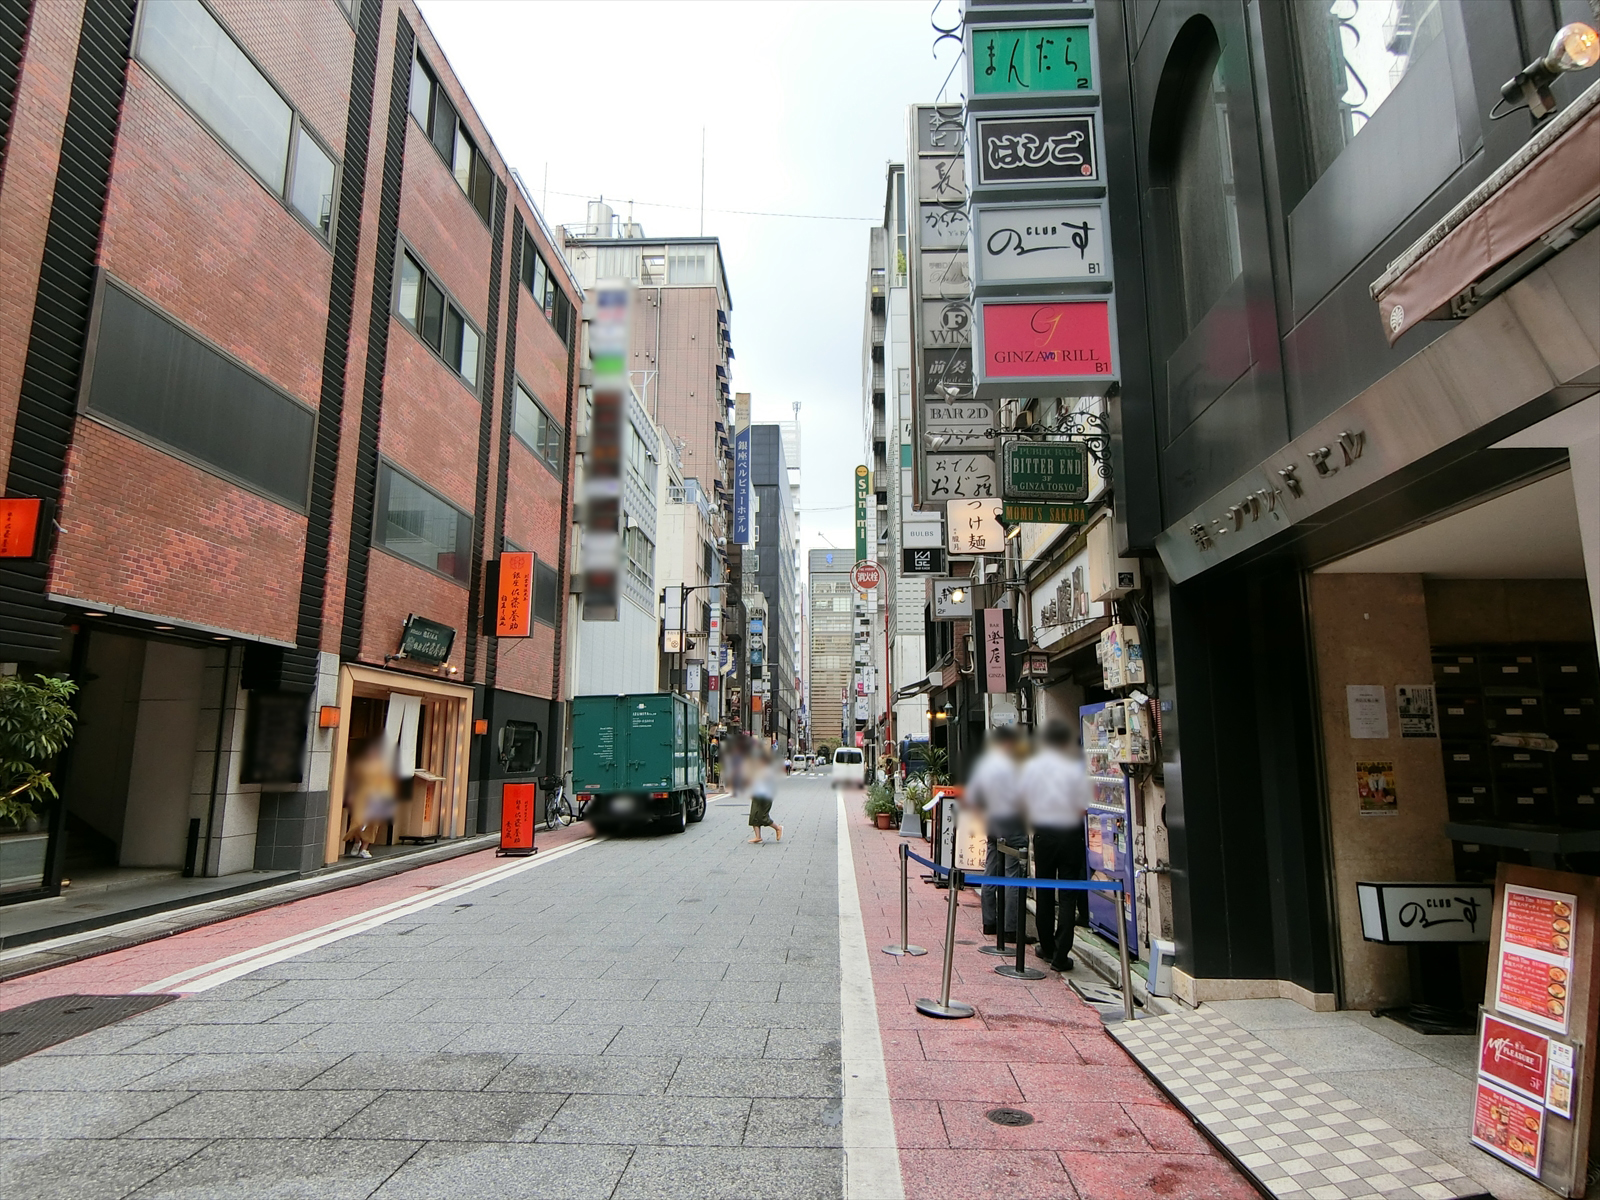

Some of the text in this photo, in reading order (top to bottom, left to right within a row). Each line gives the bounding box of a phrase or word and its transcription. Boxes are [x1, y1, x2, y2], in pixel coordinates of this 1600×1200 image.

[984, 37, 1077, 87] まんだら
[1077, 78, 1088, 88] 2
[987, 131, 1084, 169] はしご
[1026, 226, 1057, 236] CLUB
[1088, 262, 1100, 274] B1
[994, 350, 1046, 363] GINZA
[1096, 362, 1108, 372] B1
[930, 408, 988, 419] BAR 2D
[1013, 458, 1081, 475] BITTER END
[738, 440, 748, 533] 銀座ベルビューホテル
[1019, 482, 1075, 491] GINZA TOKYO
[1005, 506, 1085, 522] MOMO'S SAKABA
[967, 500, 986, 551] つけ麺
[857, 571, 879, 582] 消火栓
[1427, 899, 1451, 907] CLUB
[1503, 1047, 1535, 1065] PLEASURE
[1530, 1076, 1542, 1090] 5F
